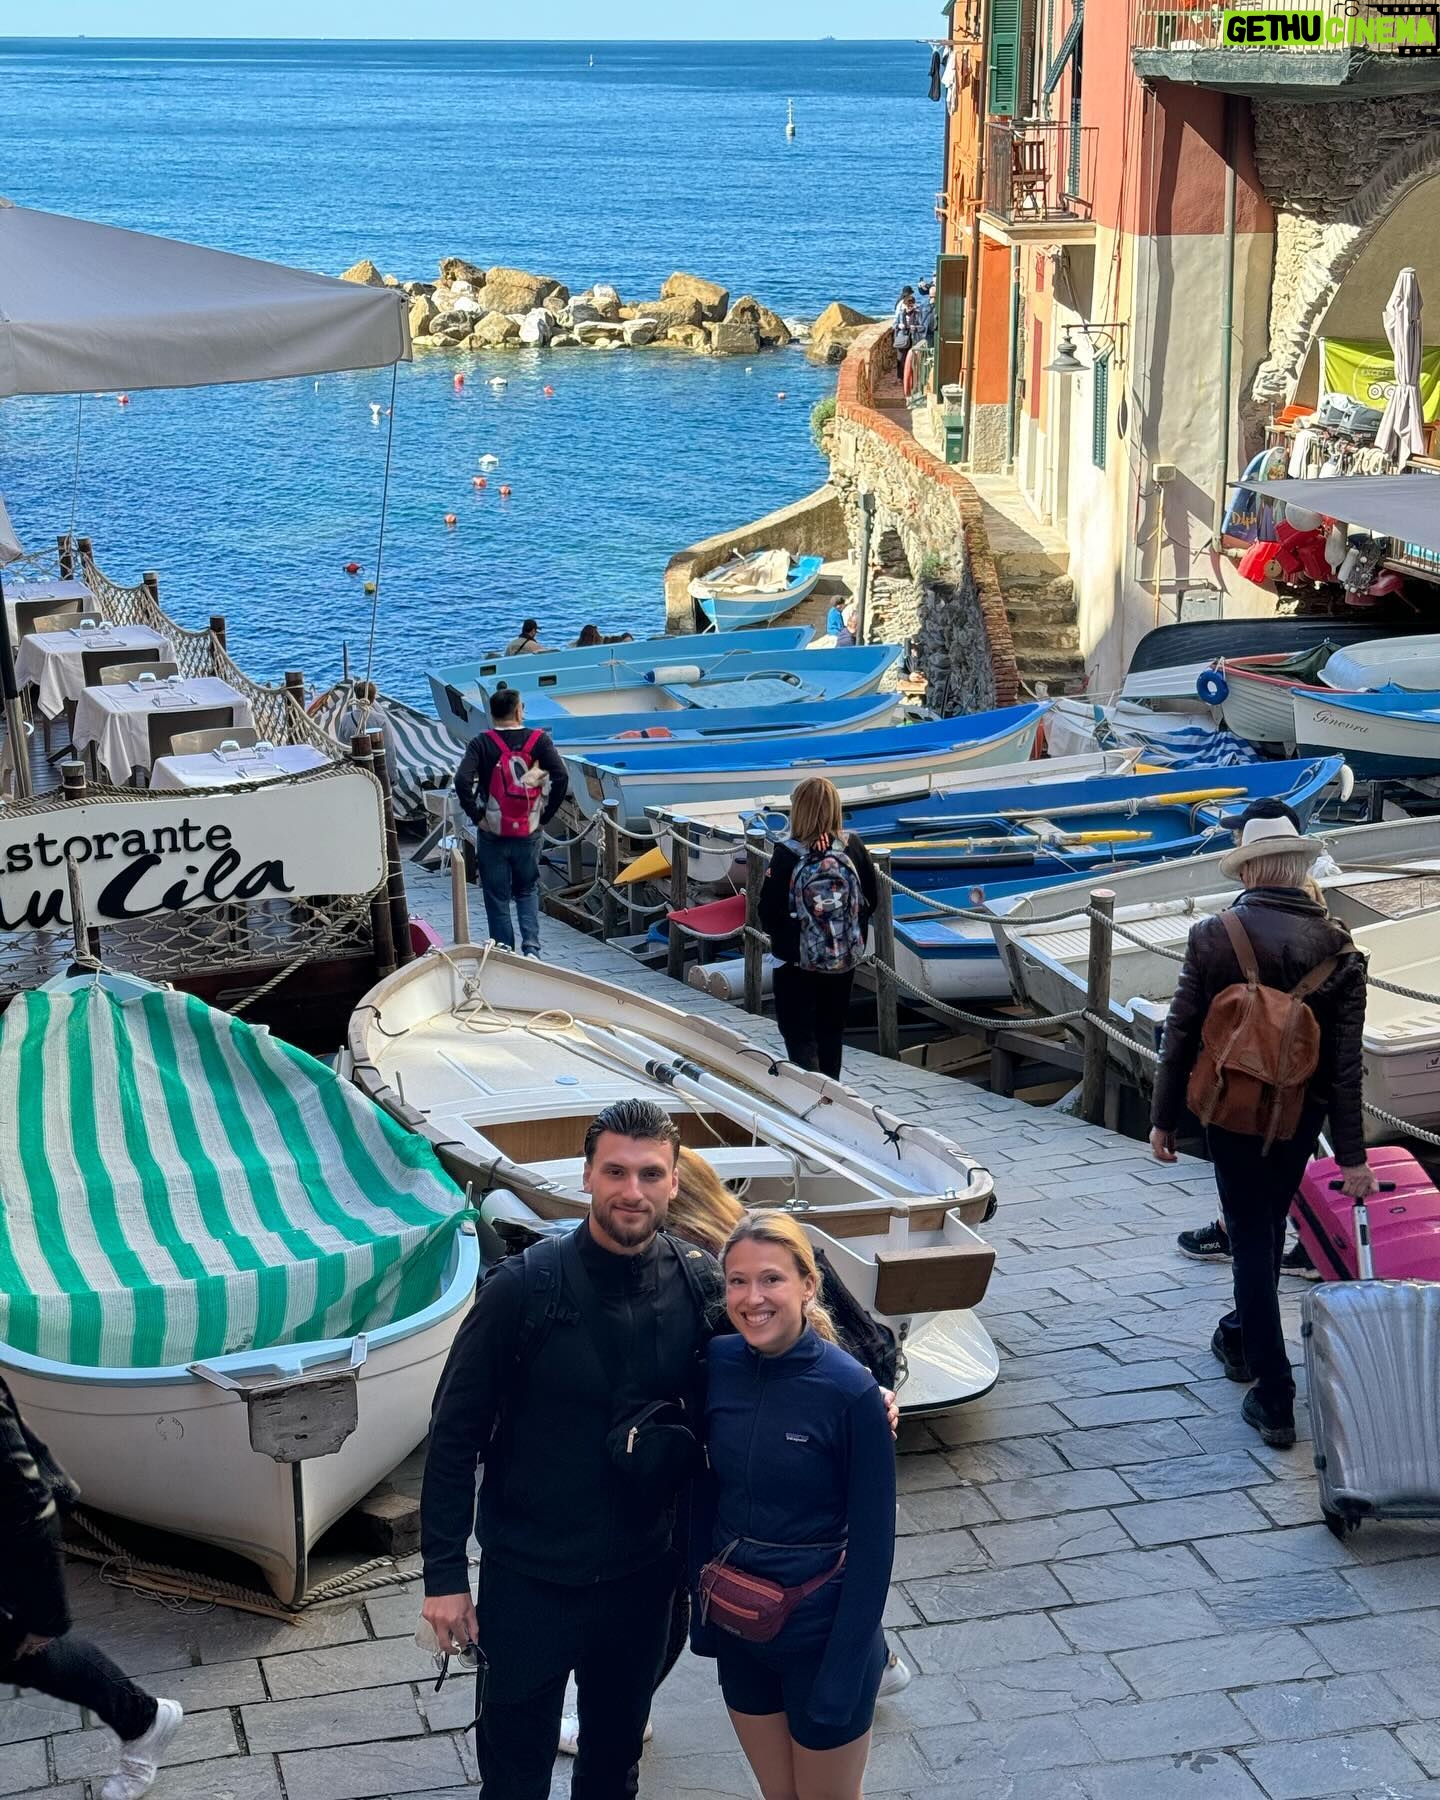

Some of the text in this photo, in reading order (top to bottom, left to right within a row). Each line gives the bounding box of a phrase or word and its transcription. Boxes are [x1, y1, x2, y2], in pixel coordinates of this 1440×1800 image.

[1312, 710, 1369, 733] Ginevra
[0, 818, 232, 876] storante
[98, 846, 295, 919] Cila
[1199, 1241, 1221, 1251] HOKA
